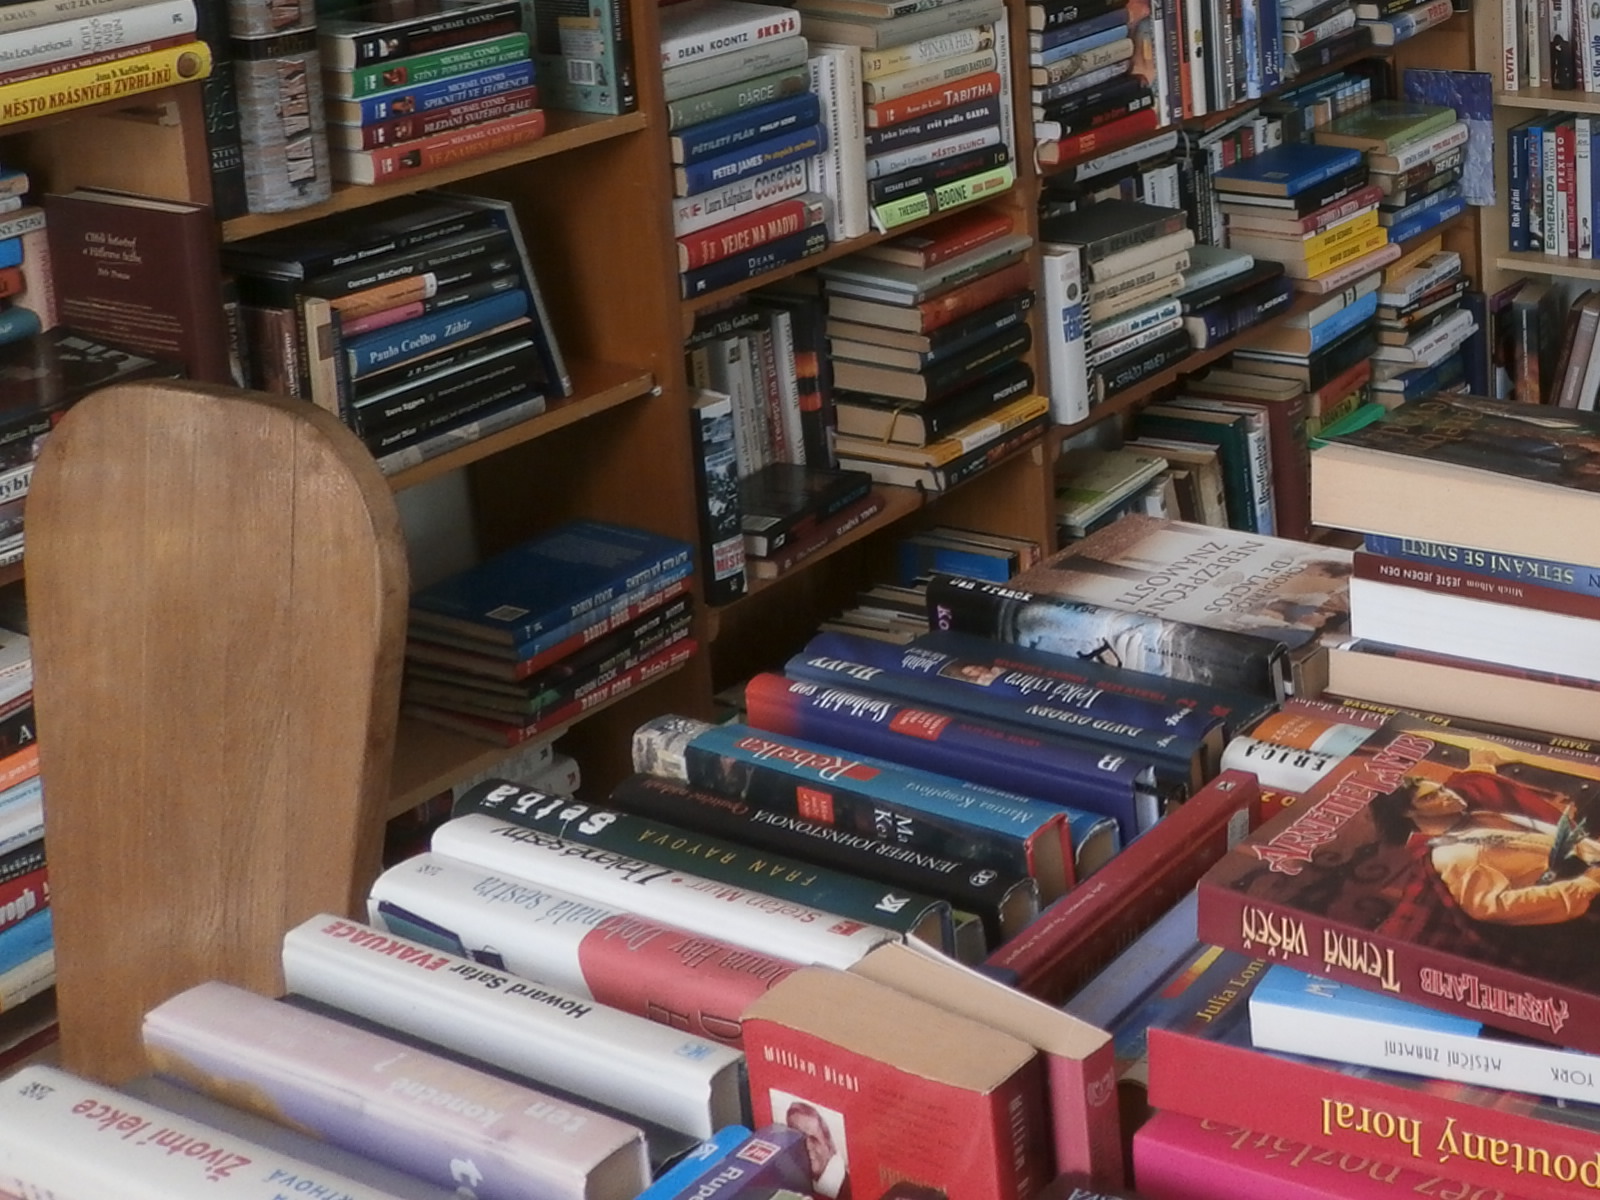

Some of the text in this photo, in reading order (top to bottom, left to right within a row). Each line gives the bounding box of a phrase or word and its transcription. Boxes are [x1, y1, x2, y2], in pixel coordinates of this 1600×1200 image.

[678, 44, 704, 59] DEAN
[709, 32, 749, 51] KOONTZ
[944, 83, 993, 105] TABITHA
[1379, 564, 1400, 577] DEN
[1463, 550, 1486, 567] SE
[1490, 557, 1576, 585] SETKÁNÍ
[1403, 568, 1433, 584] JEDEN
[740, 735, 853, 782] Rebelka
[1246, 743, 1326, 773] ERICA
[875, 840, 962, 873] JENNIFER
[748, 858, 818, 888] FRAN
[321, 921, 592, 1019] Howard Safar EVAKUACE
[1323, 929, 1401, 993] TEMNÁ
[1195, 988, 1229, 1023] Julia
[763, 1044, 817, 1077] William
[1549, 1067, 1595, 1087] YORK
[71, 1098, 253, 1184] Životní lekce
[1321, 1097, 1423, 1157] horal
